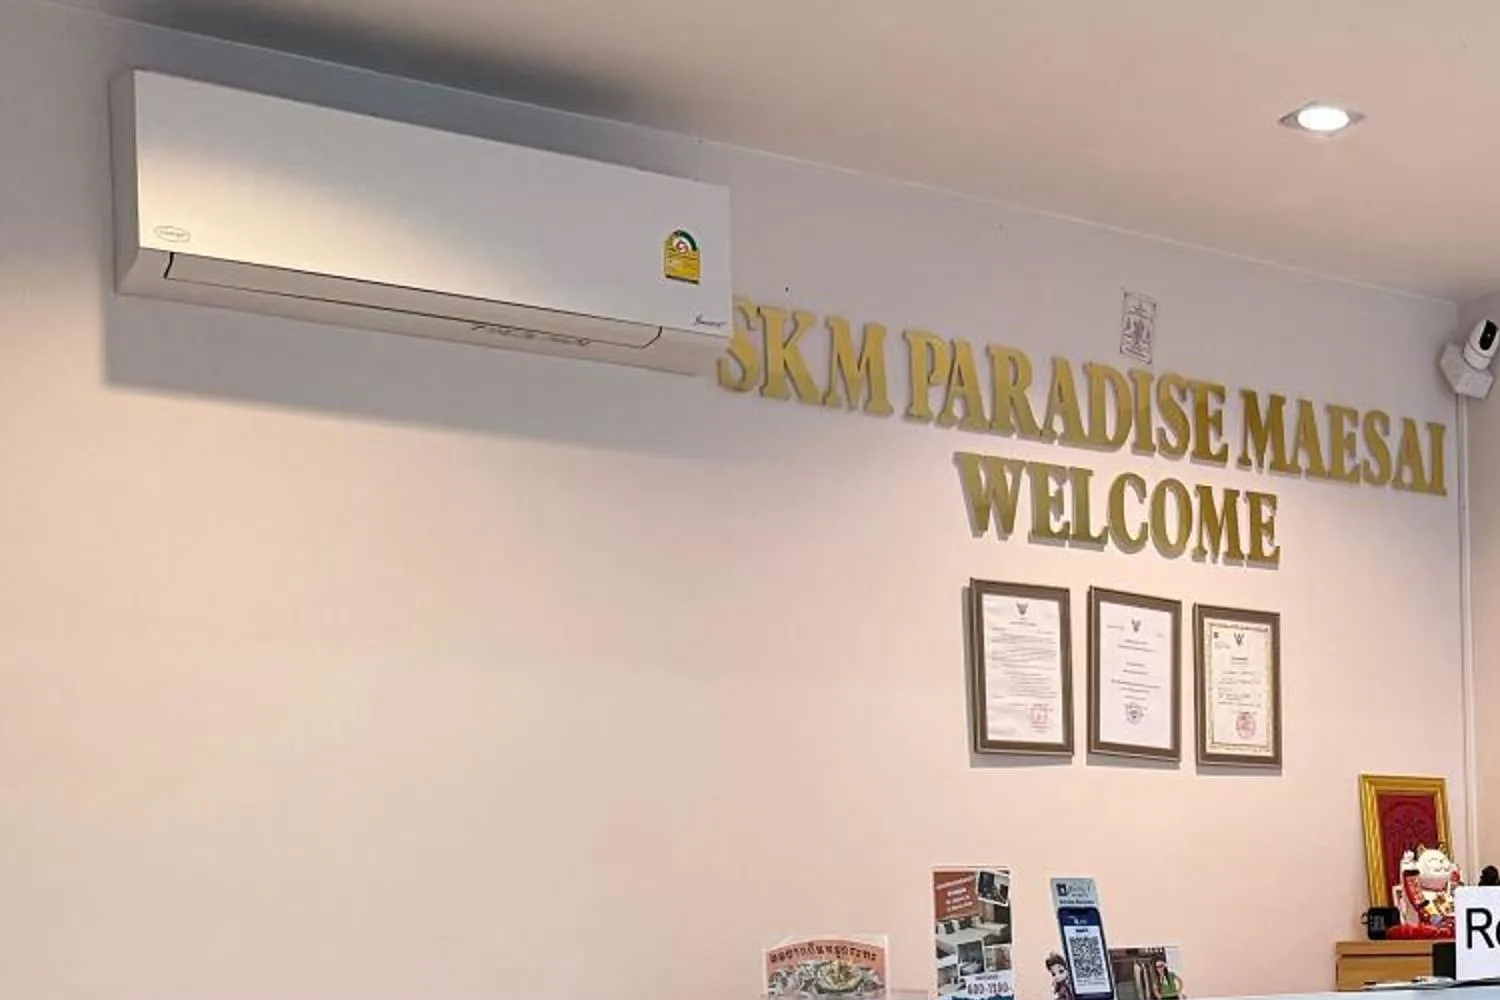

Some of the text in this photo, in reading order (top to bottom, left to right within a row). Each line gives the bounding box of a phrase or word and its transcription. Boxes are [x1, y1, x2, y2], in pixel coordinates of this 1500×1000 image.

[717, 296, 1447, 497] SKM PARADISE MAESAI
[953, 452, 1281, 568] WELCOME
